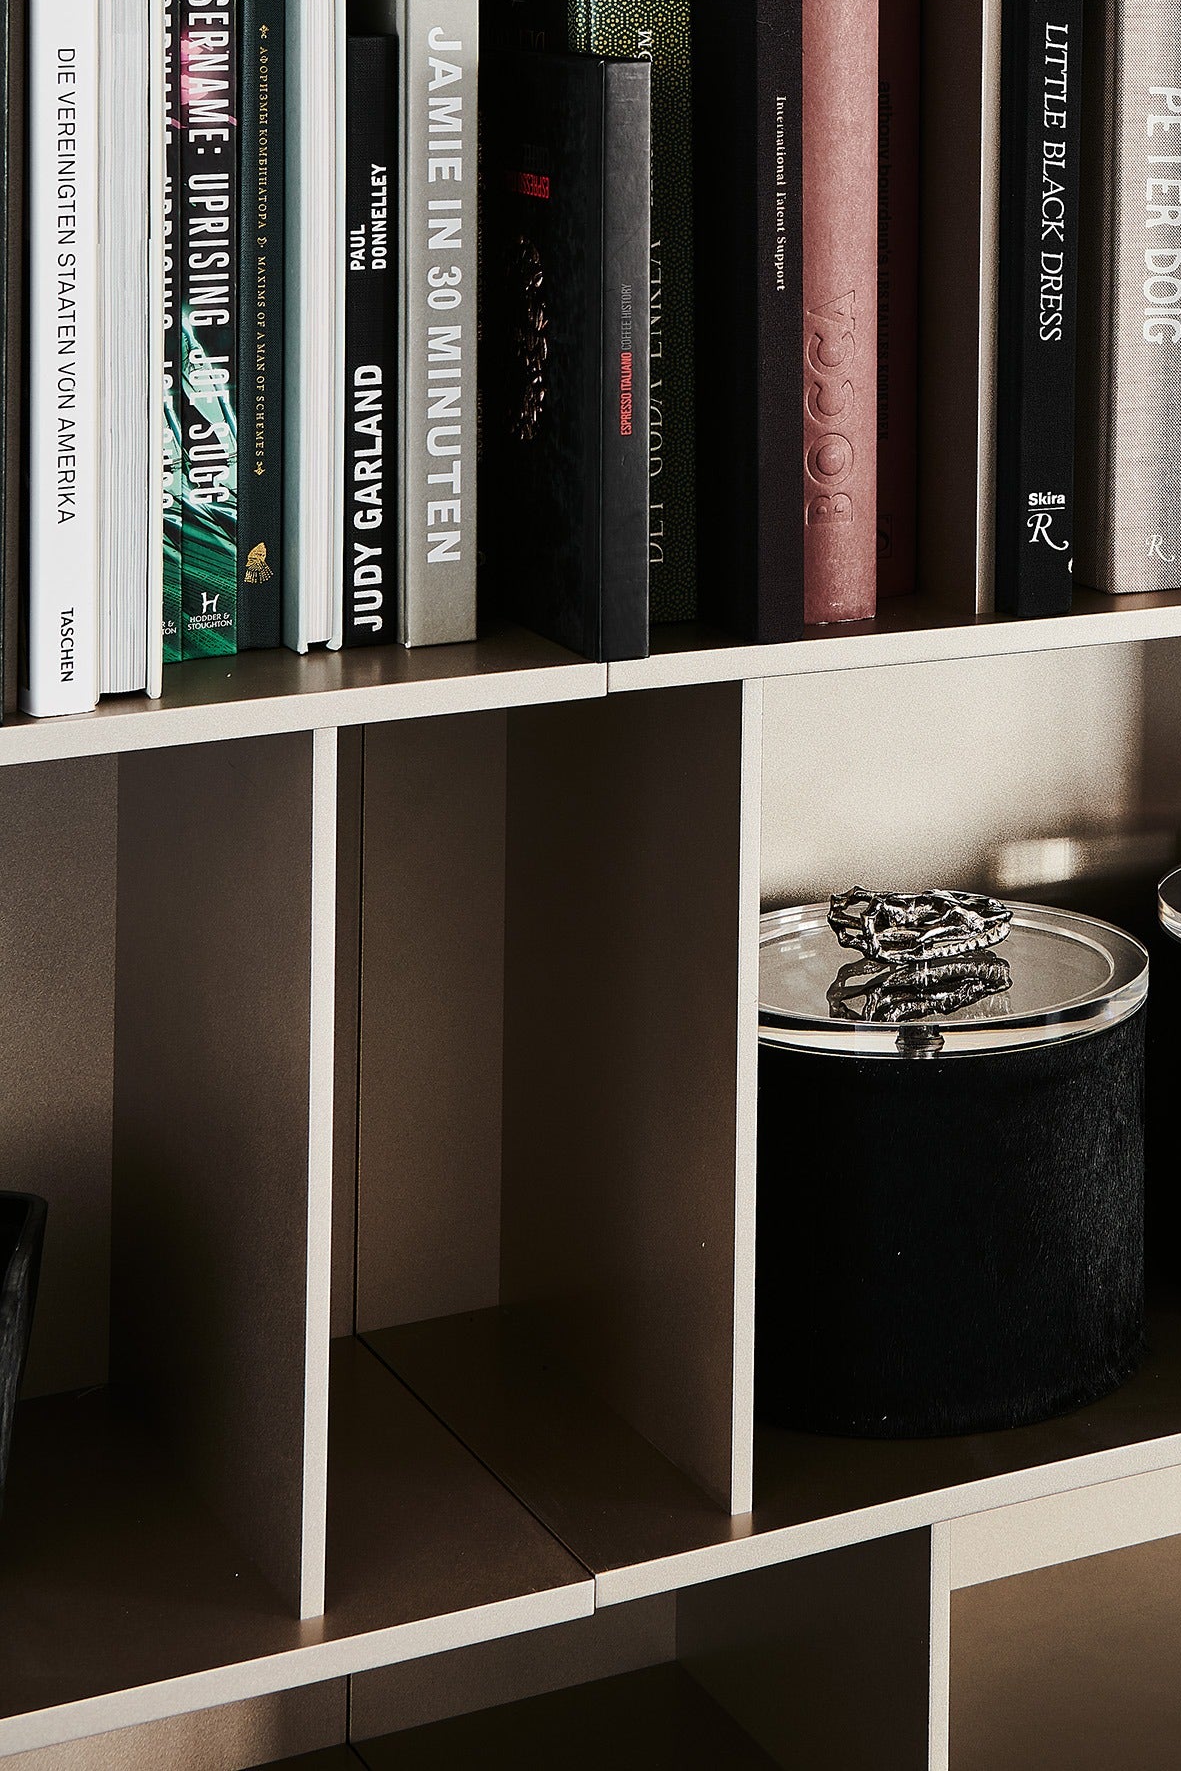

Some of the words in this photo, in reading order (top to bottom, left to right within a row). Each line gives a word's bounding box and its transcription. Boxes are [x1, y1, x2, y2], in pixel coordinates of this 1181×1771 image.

[58, 48, 77, 85] DIE
[259, 46, 269, 125] АФОРИЗМЫ
[1043, 21, 1069, 129] LITTLE
[427, 26, 462, 184] JAMIE
[58, 94, 77, 245] VEREINIGTEN
[775, 95, 787, 186] International
[371, 163, 388, 270] DONNELLEY
[1041, 140, 1066, 242] BLACK
[187, 173, 230, 326] UPRISING
[350, 224, 367, 271] PAUL
[427, 199, 462, 250] IN
[257, 256, 266, 308] MAXIMS
[427, 265, 462, 310] 30
[773, 236, 787, 291] Support
[57, 253, 76, 355] STAATEN
[257, 312, 266, 328] OF
[620, 283, 632, 320] HISTORY
[1039, 251, 1064, 341] DRESS
[256, 332, 265, 341] A
[256, 344, 265, 372] MAN
[620, 320, 632, 351] COFFEE
[57, 361, 76, 410] VON
[187, 347, 230, 408] JOE
[256, 375, 265, 392] OF
[620, 351, 632, 391] ITALIANO
[255, 395, 265, 458] SCHEMES
[620, 392, 632, 436] ESPRESSO
[804, 289, 855, 526] BOCCA
[57, 417, 76, 525] AMERIKA
[187, 423, 230, 504] SUGG
[354, 365, 383, 530] GARLAND
[427, 325, 462, 564] MINUTEN
[1028, 491, 1066, 506] Skira
[1026, 513, 1070, 551] R
[354, 543, 383, 632] JUDY
[60, 607, 75, 684] TASCHEN
[187, 620, 233, 630] STOUGHTON
[189, 614, 222, 624] HODDER
